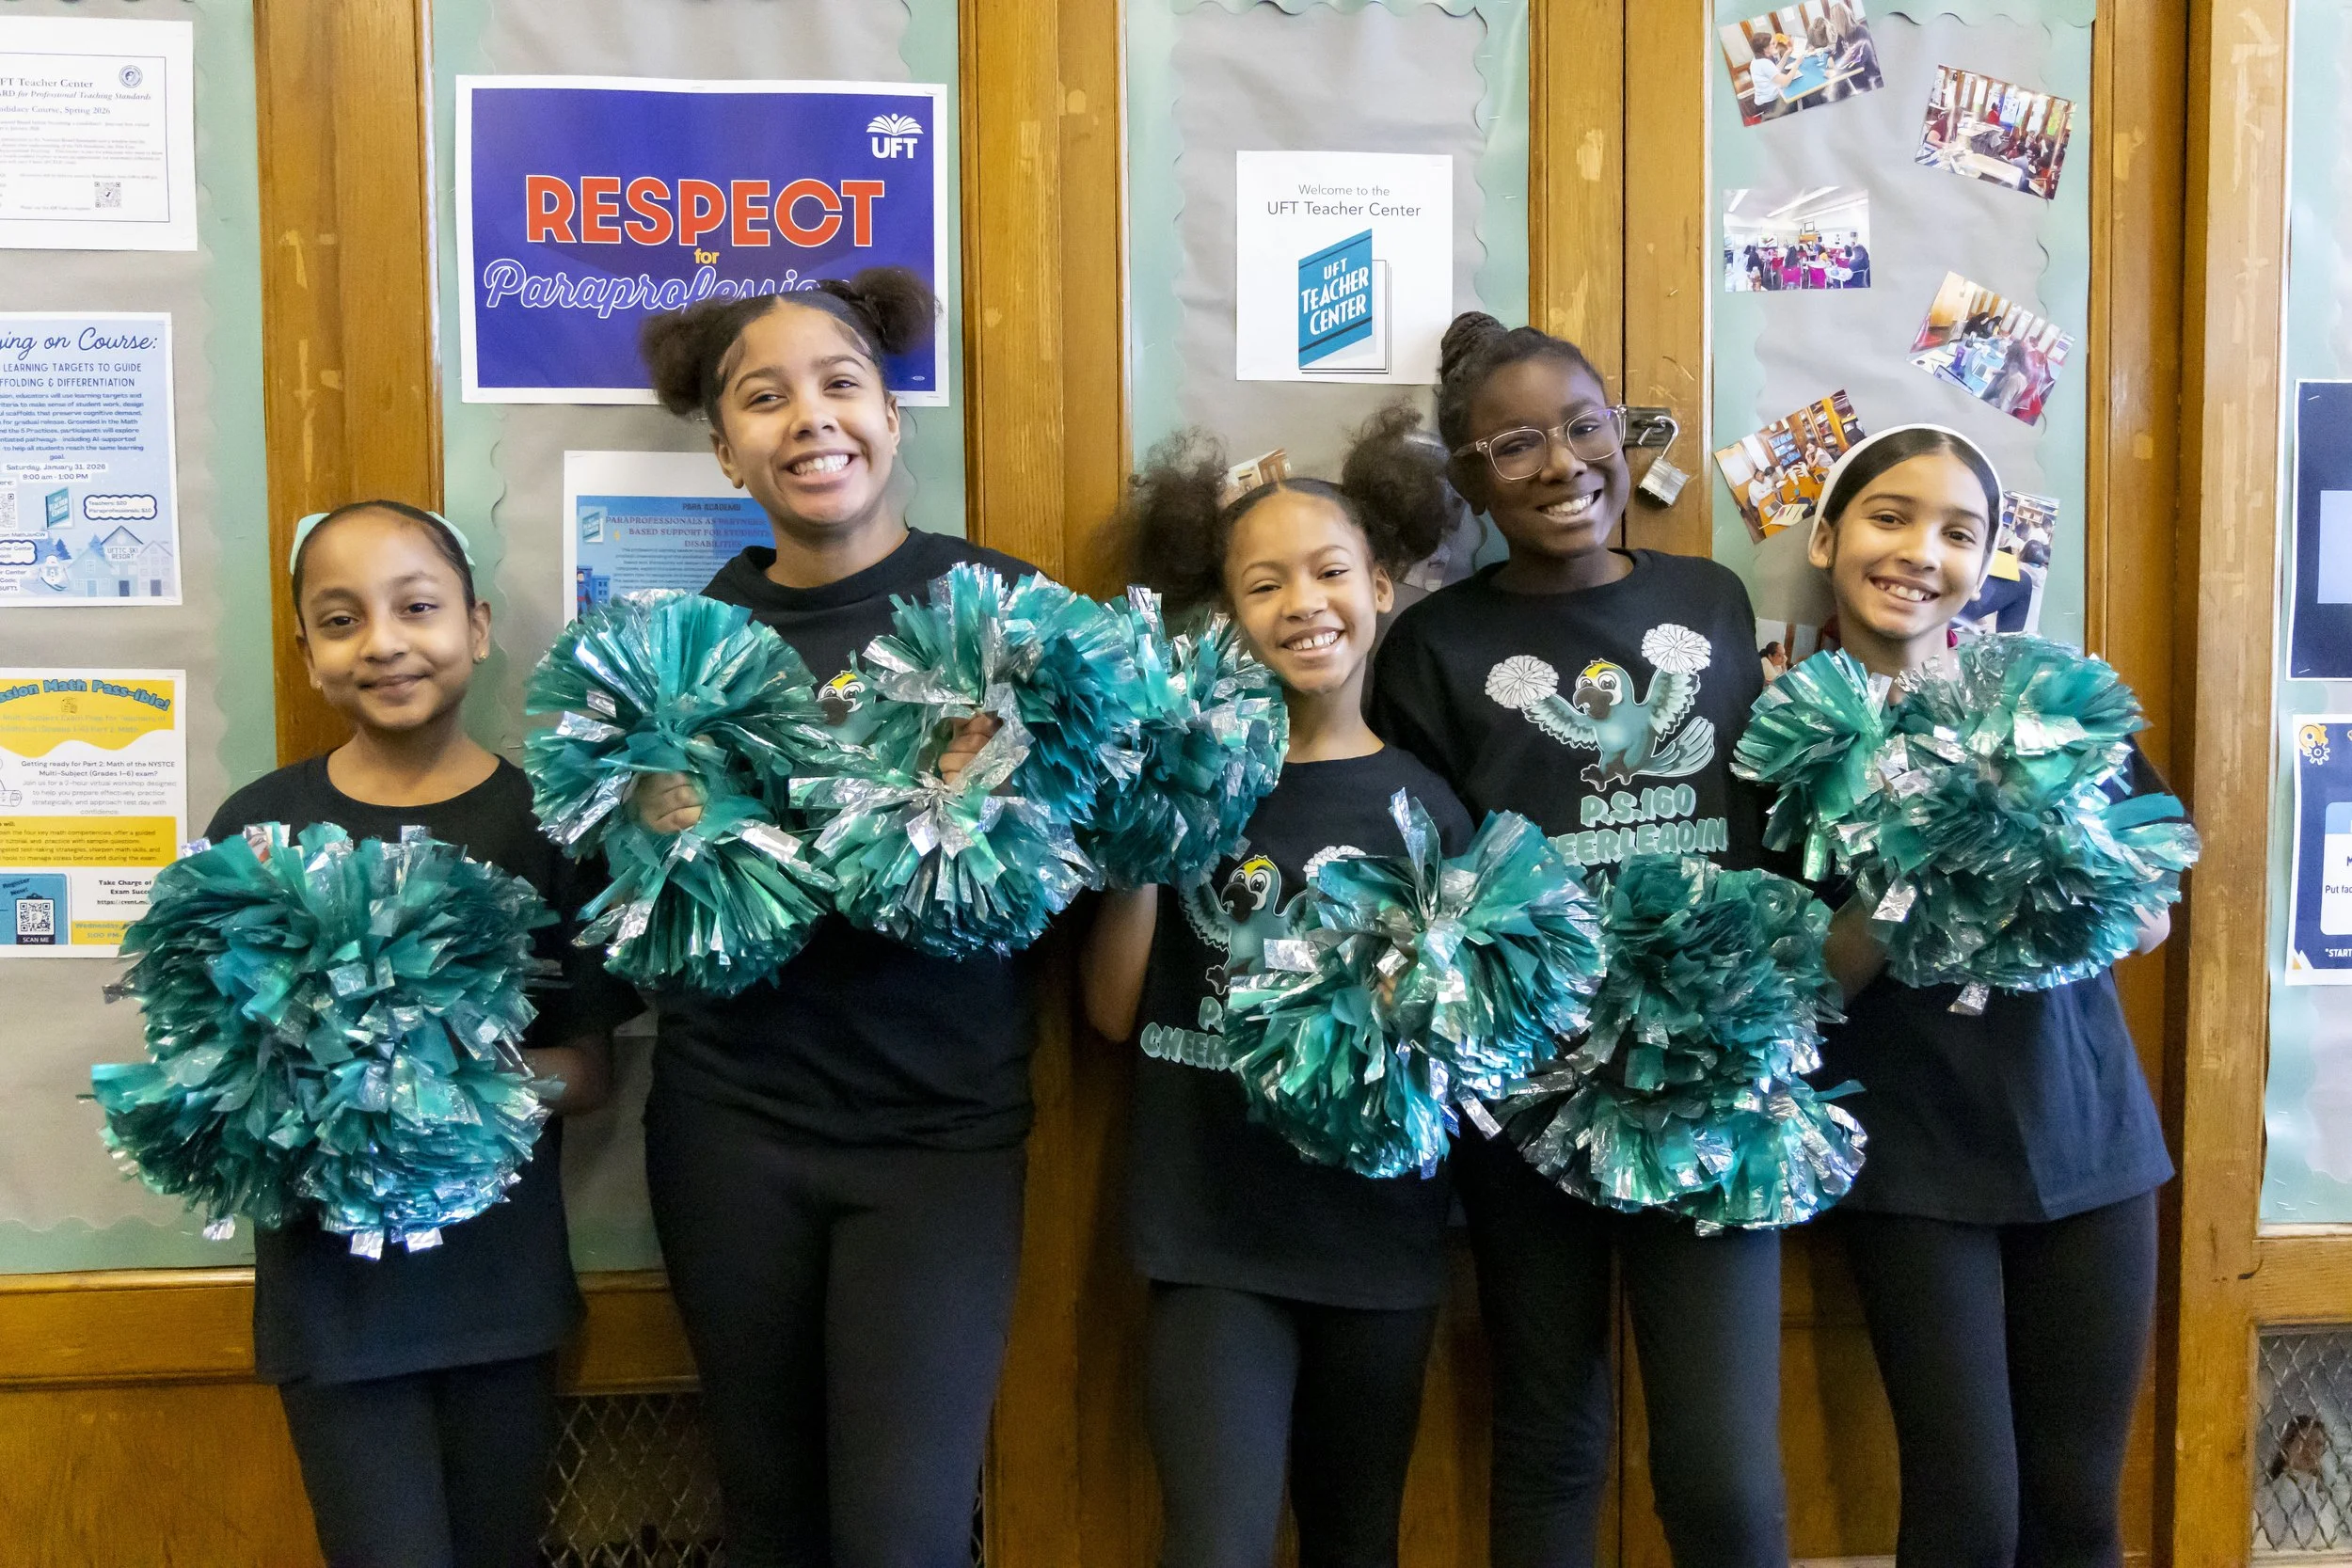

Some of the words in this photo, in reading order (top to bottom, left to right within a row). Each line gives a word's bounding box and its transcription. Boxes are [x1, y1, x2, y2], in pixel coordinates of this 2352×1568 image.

[0, 77, 14, 86] FT
[17, 77, 56, 87] Teacher
[60, 78, 93, 87] Center
[30, 90, 76, 100] Professional
[80, 91, 113, 101] Teaching
[115, 92, 151, 101] Standards
[0, 105, 29, 115] ndidacy
[32, 105, 62, 114] Course,
[64, 106, 90, 115] Spring
[871, 137, 918, 159] UFT
[1298, 184, 1352, 197] Welcome
[1357, 186, 1368, 197] to
[1372, 185, 1391, 197] the
[526, 174, 885, 248] RESPECT
[1267, 201, 1299, 215] UFT
[1304, 201, 1364, 216] Teacher
[1369, 202, 1422, 216] Center
[694, 247, 720, 265] for
[1324, 258, 1347, 280] UFT
[1301, 266, 1369, 314] TEACHER
[1310, 293, 1366, 336] CENTER
[0, 331, 38, 361] ing
[43, 336, 72, 350] on
[78, 326, 158, 351] Course:
[3, 363, 49, 372] LEARNING
[53, 363, 94, 372] TARGETS
[98, 363, 110, 372] TO
[114, 363, 142, 372] GUIDE
[0, 378, 44, 387] FFOLDING
[48, 377, 54, 388] &
[57, 378, 135, 387] DIFFERENTIATION
[7, 464, 41, 472] Saturday,
[43, 464, 73, 472] January
[0, 684, 40, 703] ssion
[43, 678, 87, 693] Math
[1581, 783, 1696, 828] P.S.160
[1548, 817, 1728, 866] EERLEADIN
[2325, 885, 2338, 894] Put
[1140, 1022, 1230, 1071] CHEER
